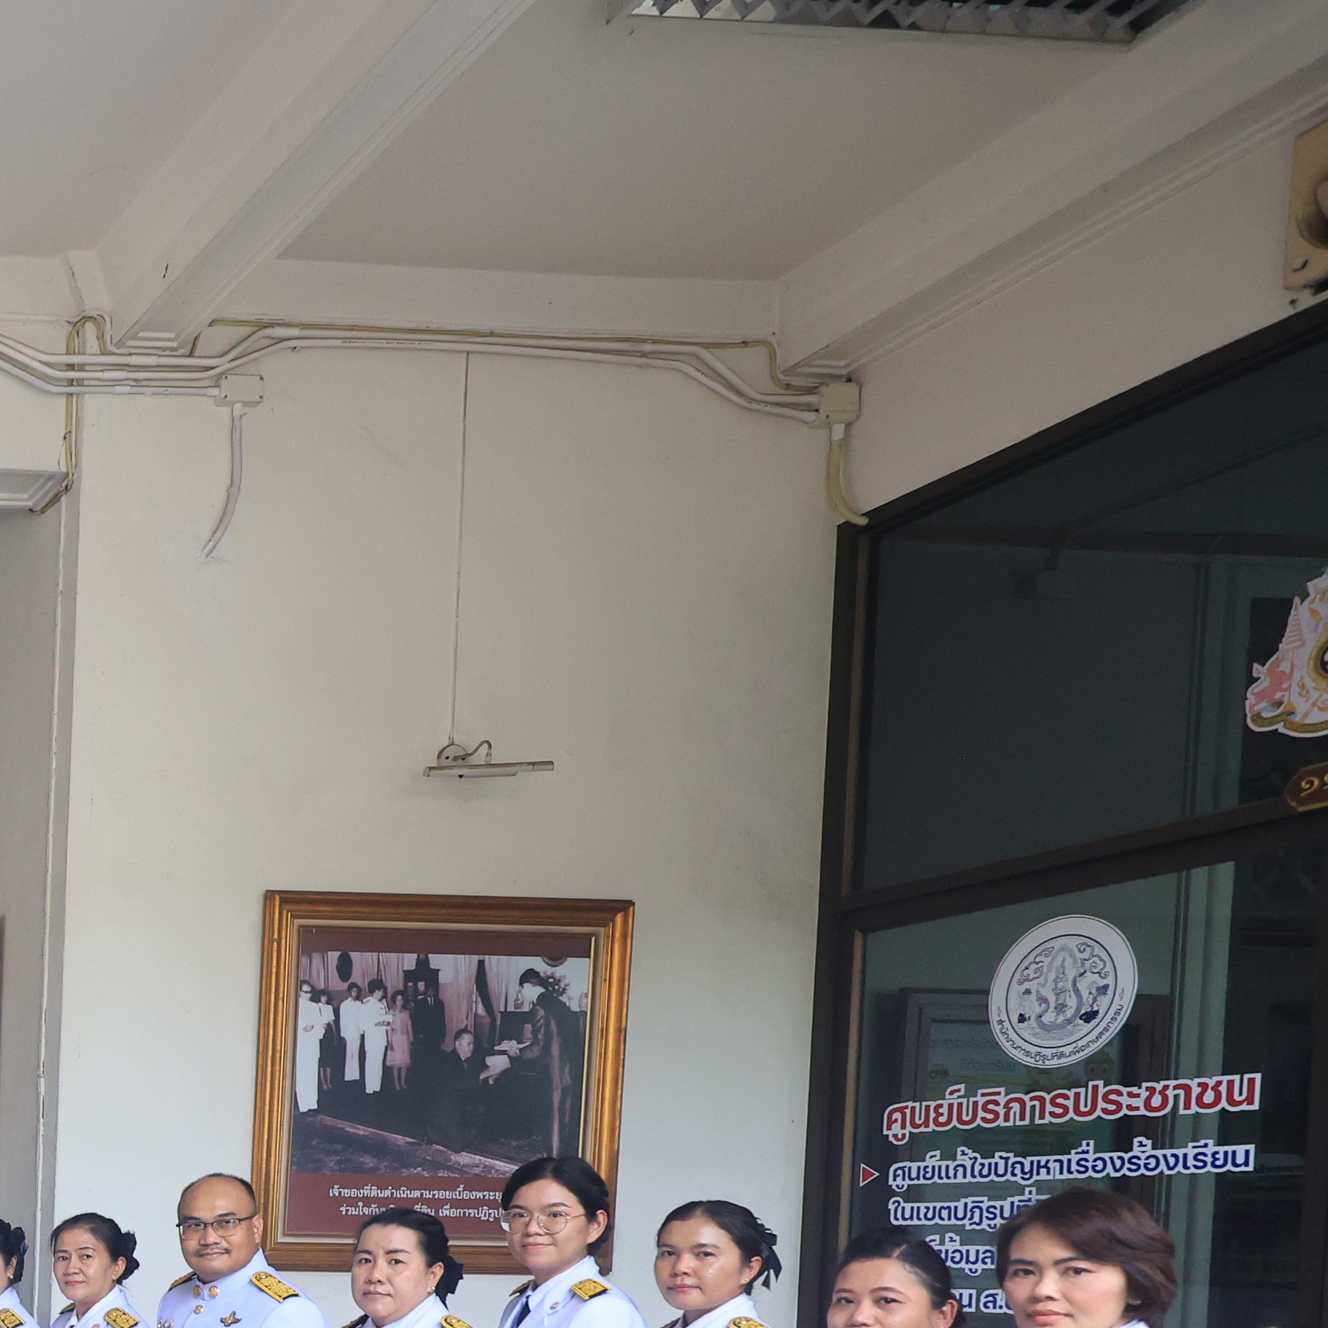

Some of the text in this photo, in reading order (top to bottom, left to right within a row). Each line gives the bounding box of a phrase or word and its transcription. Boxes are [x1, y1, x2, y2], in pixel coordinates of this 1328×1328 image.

[884, 1075, 1258, 1143] ศูนย์บริการประชาชน
[891, 1138, 1252, 1190] ศูนย์แก้ไขปัญหาเรื่องร้องเรียน
[329, 1184, 503, 1203] เจ้าของที่ดินดำเนินตามรอยเบื้องพระยุ
[439, 1203, 505, 1221] เพื่อการปฏิรูป
